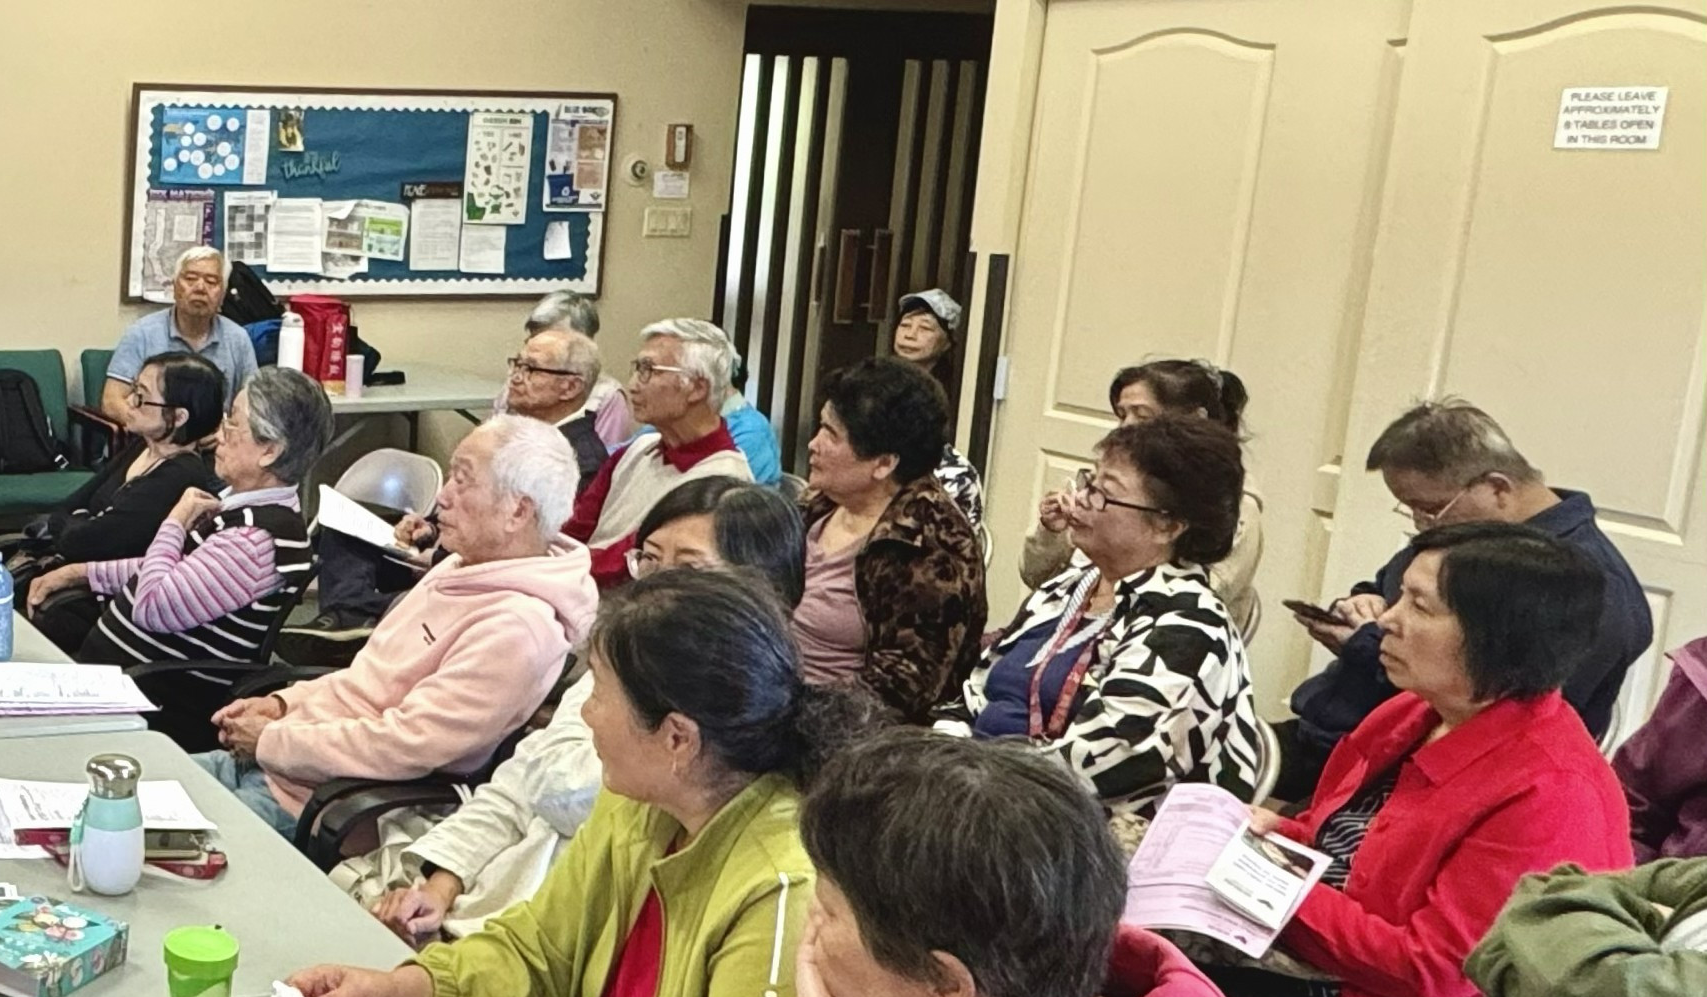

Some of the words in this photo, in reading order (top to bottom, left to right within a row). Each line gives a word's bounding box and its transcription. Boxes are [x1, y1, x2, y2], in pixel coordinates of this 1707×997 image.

[1571, 92, 1615, 101] PLEASE
[1618, 91, 1657, 101] LEAVE
[1563, 105, 1661, 114] APPROXIMATELY
[1574, 120, 1618, 129] TABLES
[1620, 120, 1655, 129] OPEN
[1567, 135, 1578, 143] IN
[1581, 135, 1608, 144] THIS
[1610, 135, 1647, 144] ROOM
